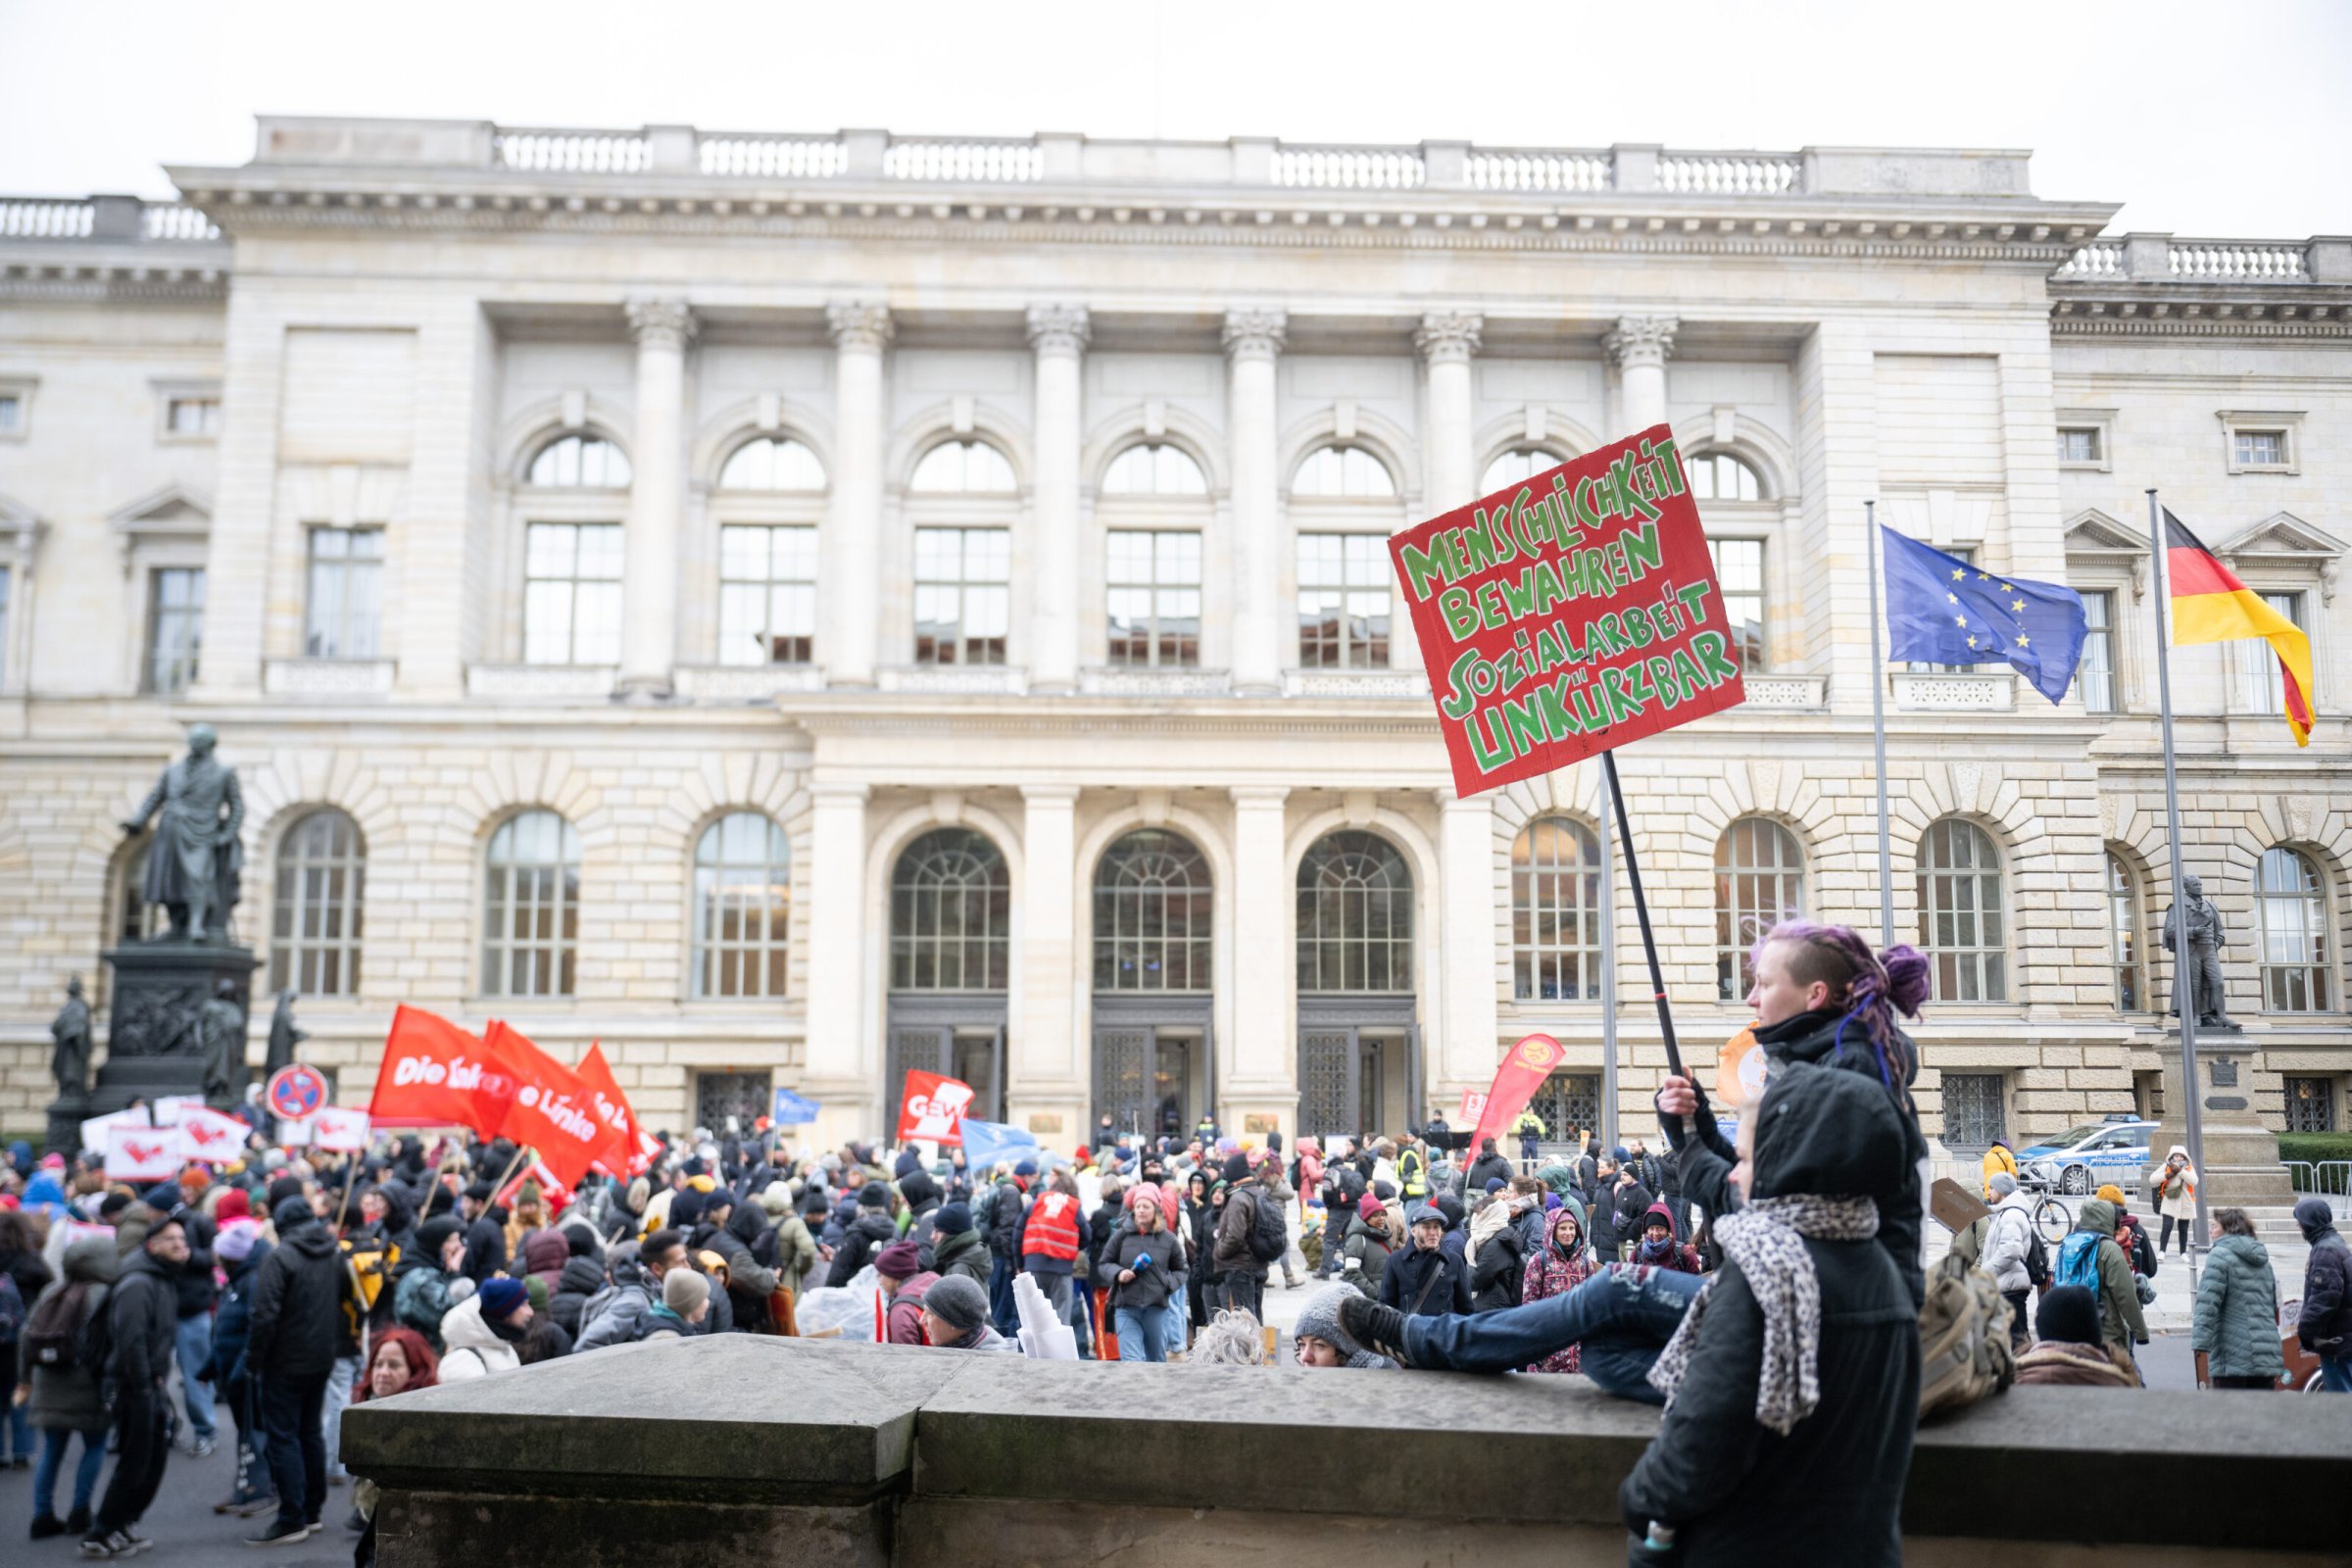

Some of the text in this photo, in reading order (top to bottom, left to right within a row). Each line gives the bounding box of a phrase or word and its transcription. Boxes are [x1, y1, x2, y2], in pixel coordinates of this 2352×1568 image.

[1438, 521, 1663, 643] BEWAHREN
[1464, 630, 1739, 775] UNKÜRZBAR
[394, 1054, 447, 1087] Die
[539, 1088, 597, 1143] Linke
